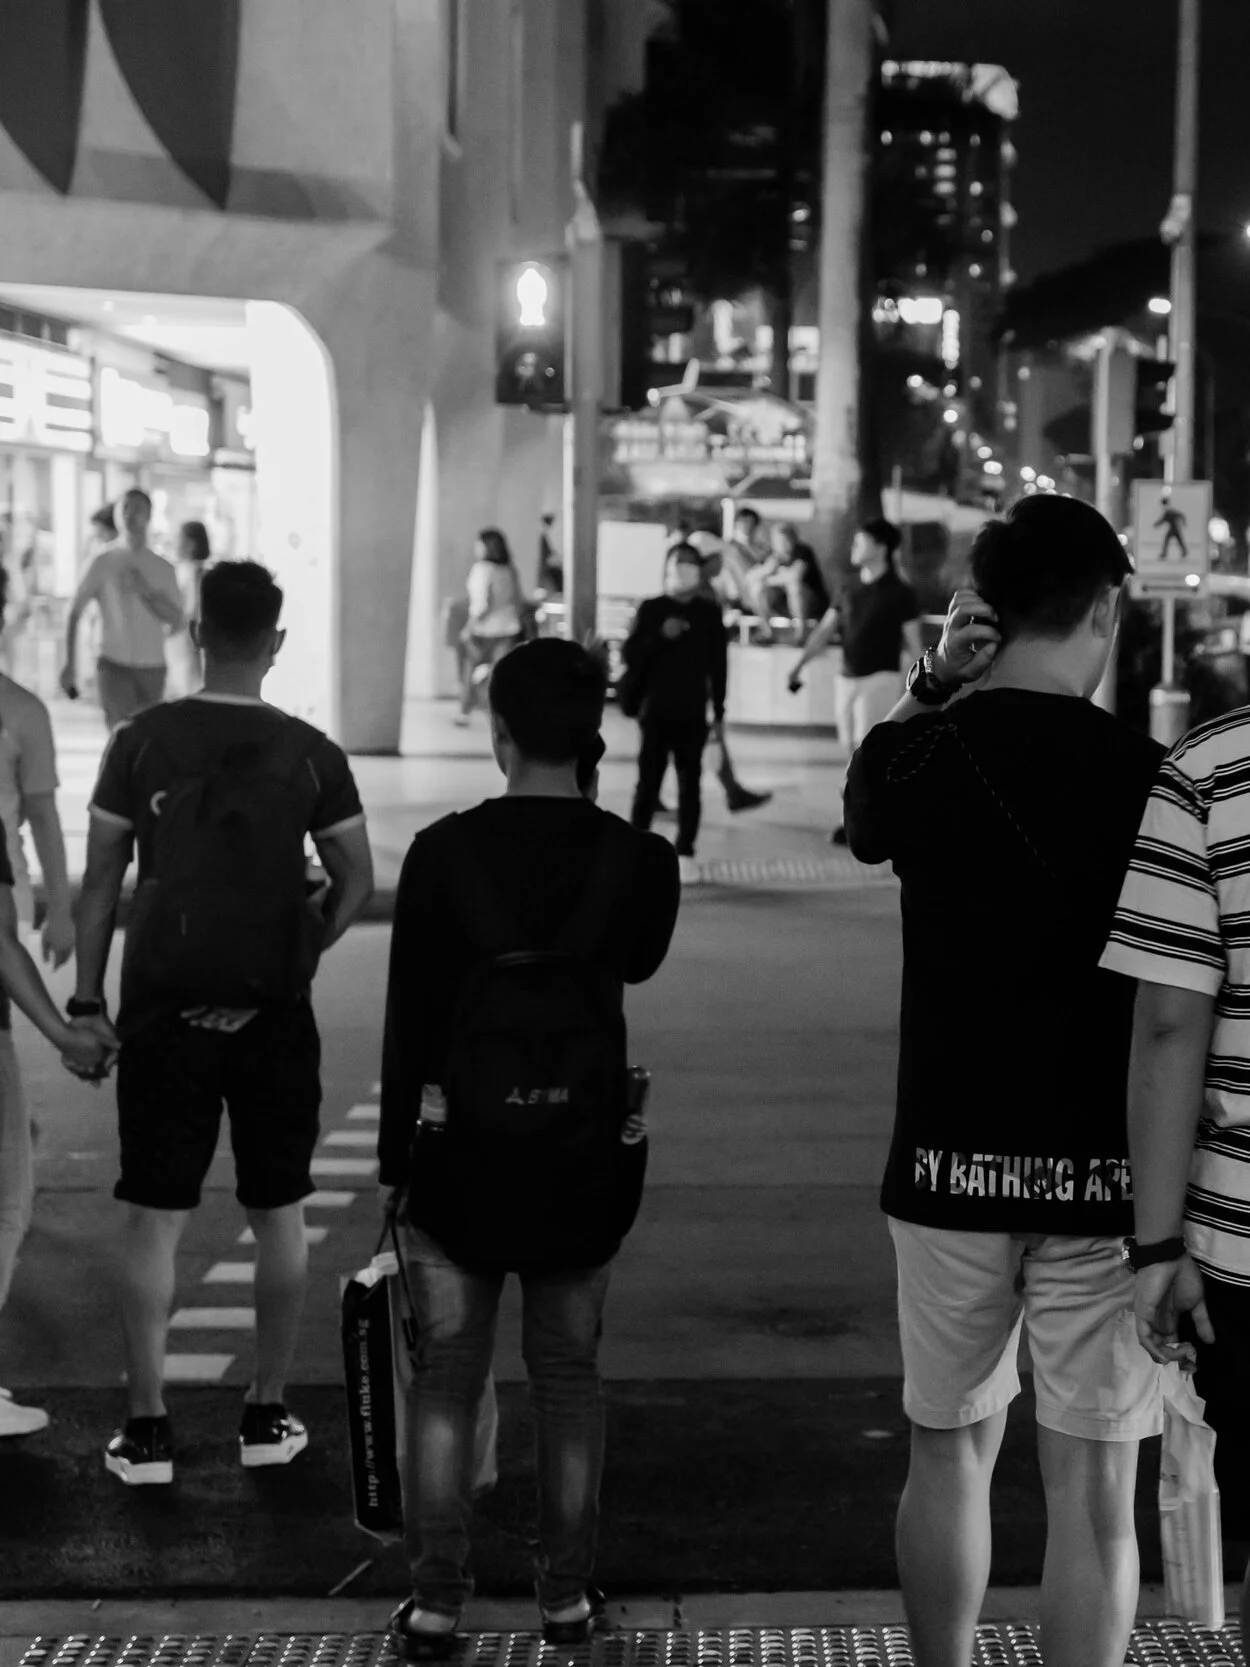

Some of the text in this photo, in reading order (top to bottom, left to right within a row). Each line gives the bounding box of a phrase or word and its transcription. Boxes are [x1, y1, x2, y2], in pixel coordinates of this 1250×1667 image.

[915, 1147, 1133, 1201] BY BATHING APE
